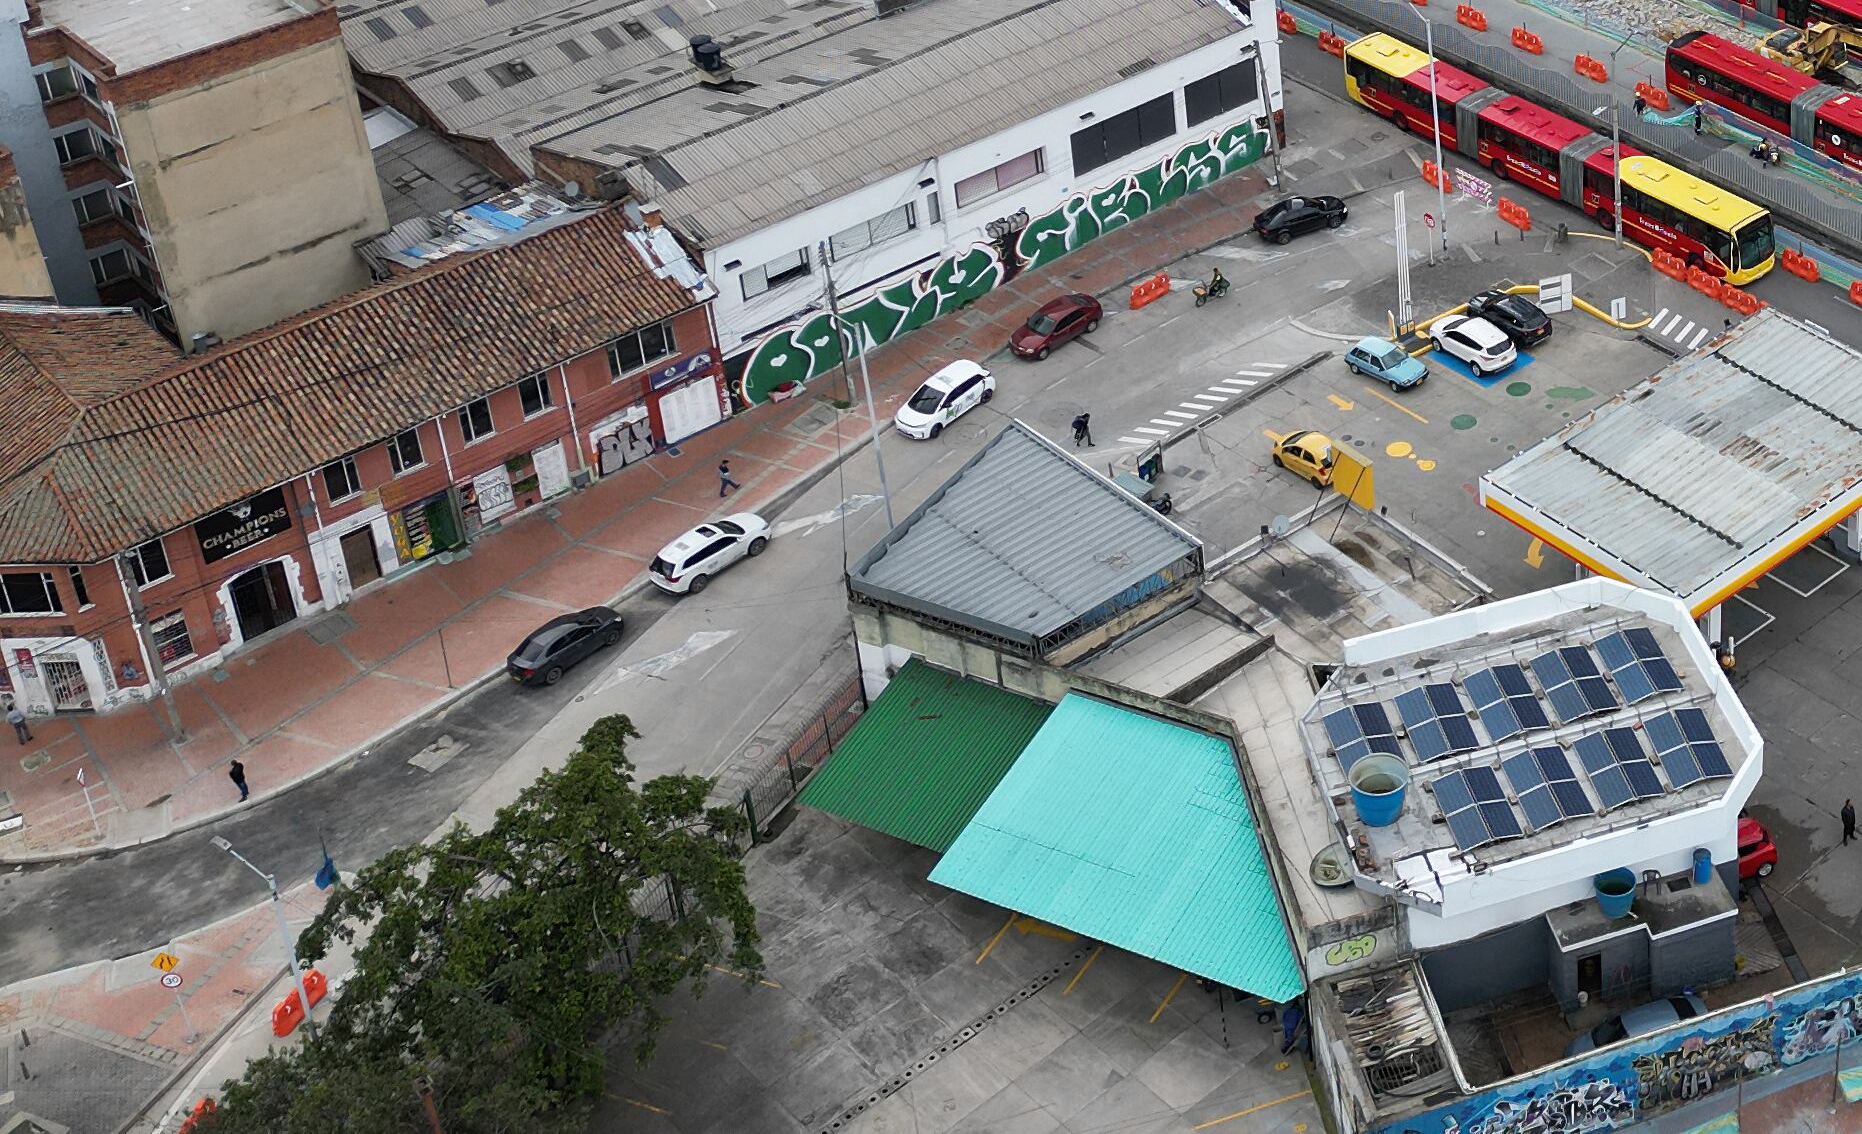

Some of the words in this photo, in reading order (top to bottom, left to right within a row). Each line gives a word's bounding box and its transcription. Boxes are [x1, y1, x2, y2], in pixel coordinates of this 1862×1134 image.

[203, 507, 287, 549] CHAMPIONS
[232, 529, 264, 548] BEER
[165, 976, 178, 985] 30
